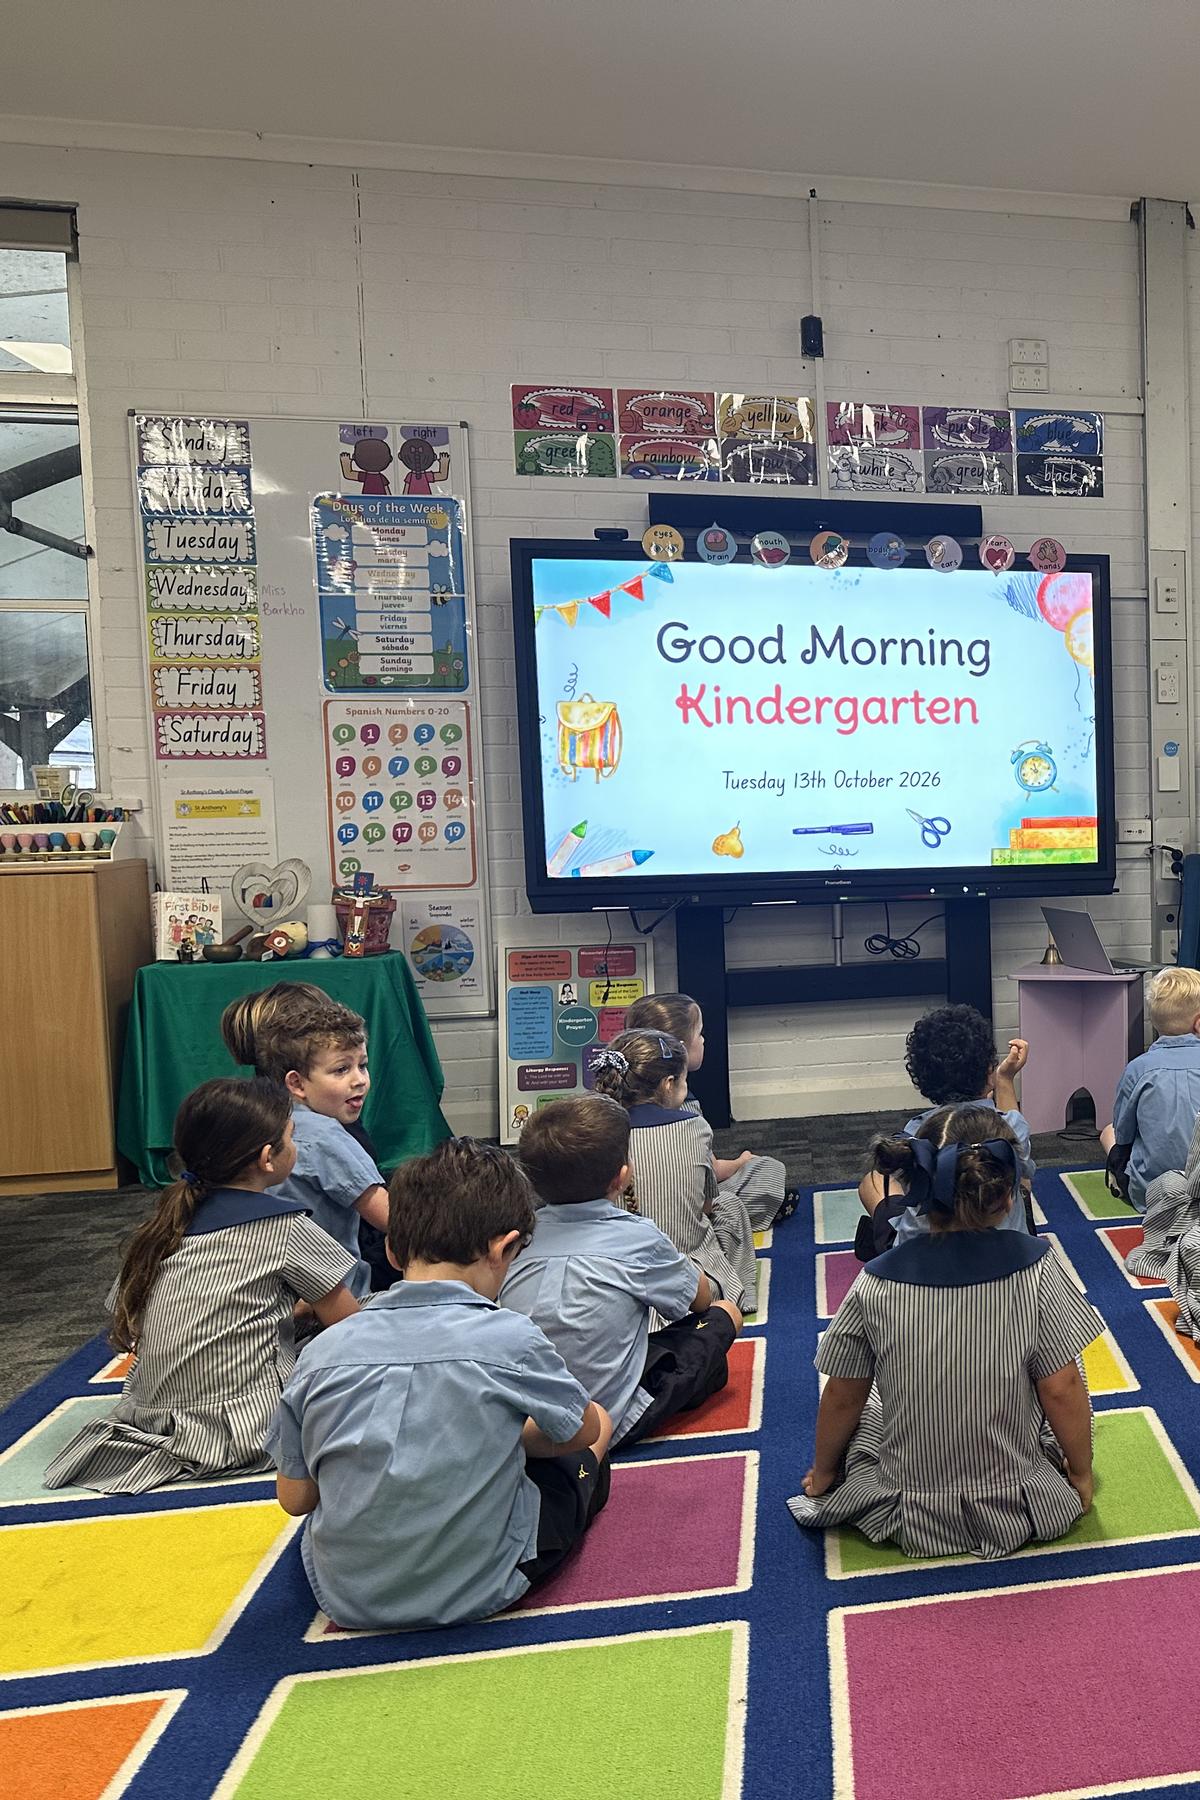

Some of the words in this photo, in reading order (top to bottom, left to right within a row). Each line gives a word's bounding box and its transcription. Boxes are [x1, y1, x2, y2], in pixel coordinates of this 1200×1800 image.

[552, 397, 575, 416] red
[643, 404, 691, 426] orange
[748, 404, 792, 429] yellow
[353, 425, 373, 437] left
[413, 428, 437, 439] right
[1047, 420, 1072, 441] blue
[161, 427, 227, 461] Snday
[546, 446, 585, 465] gree
[643, 447, 696, 465] rainbow
[957, 465, 984, 484] grey
[1044, 464, 1078, 483] black
[332, 502, 364, 517] Days
[369, 502, 381, 514] of
[385, 502, 405, 513] the
[410, 503, 444, 514] Week
[653, 529, 673, 539] eyes
[163, 525, 239, 559] Tuesday
[985, 538, 1007, 547] heart
[707, 552, 729, 561] brain
[941, 559, 958, 569] ears
[156, 575, 248, 606] Wednesday
[261, 584, 286, 596] Miss
[380, 614, 407, 624] Friday
[161, 622, 245, 656] Thursday
[375, 636, 415, 644] Saturday
[656, 621, 787, 666] Good
[800, 623, 992, 677] Morning
[380, 657, 412, 665] Sunday
[380, 665, 413, 673] domingo
[177, 673, 236, 705] Friday
[345, 707, 382, 717] Spanish
[385, 707, 425, 716] Numbers
[675, 682, 980, 736] Kindergarten
[170, 720, 252, 752] Saturday
[340, 729, 348, 738] 0
[367, 729, 374, 738] 1
[394, 729, 401, 738] 2
[421, 729, 428, 738] 3
[446, 729, 455, 738] 4
[342, 762, 349, 771] 5
[368, 762, 375, 771] 6
[394, 762, 402, 771] 7
[422, 761, 430, 771] 8
[448, 761, 455, 771] 9
[722, 769, 786, 797] Tuesday
[793, 770, 826, 790] 13th
[834, 769, 893, 789] October
[899, 770, 941, 788] 2026
[338, 797, 352, 806] 10
[367, 797, 378, 806] 11
[395, 796, 408, 805] 12
[420, 796, 433, 805] 13
[446, 795, 460, 804] 14
[340, 829, 354, 838] 15
[367, 828, 381, 838] 16
[395, 828, 409, 837] 17
[421, 827, 435, 836] 18
[447, 827, 461, 836] 19
[342, 862, 357, 871] 20
[165, 902, 189, 912] First
[191, 902, 219, 912] Bible
